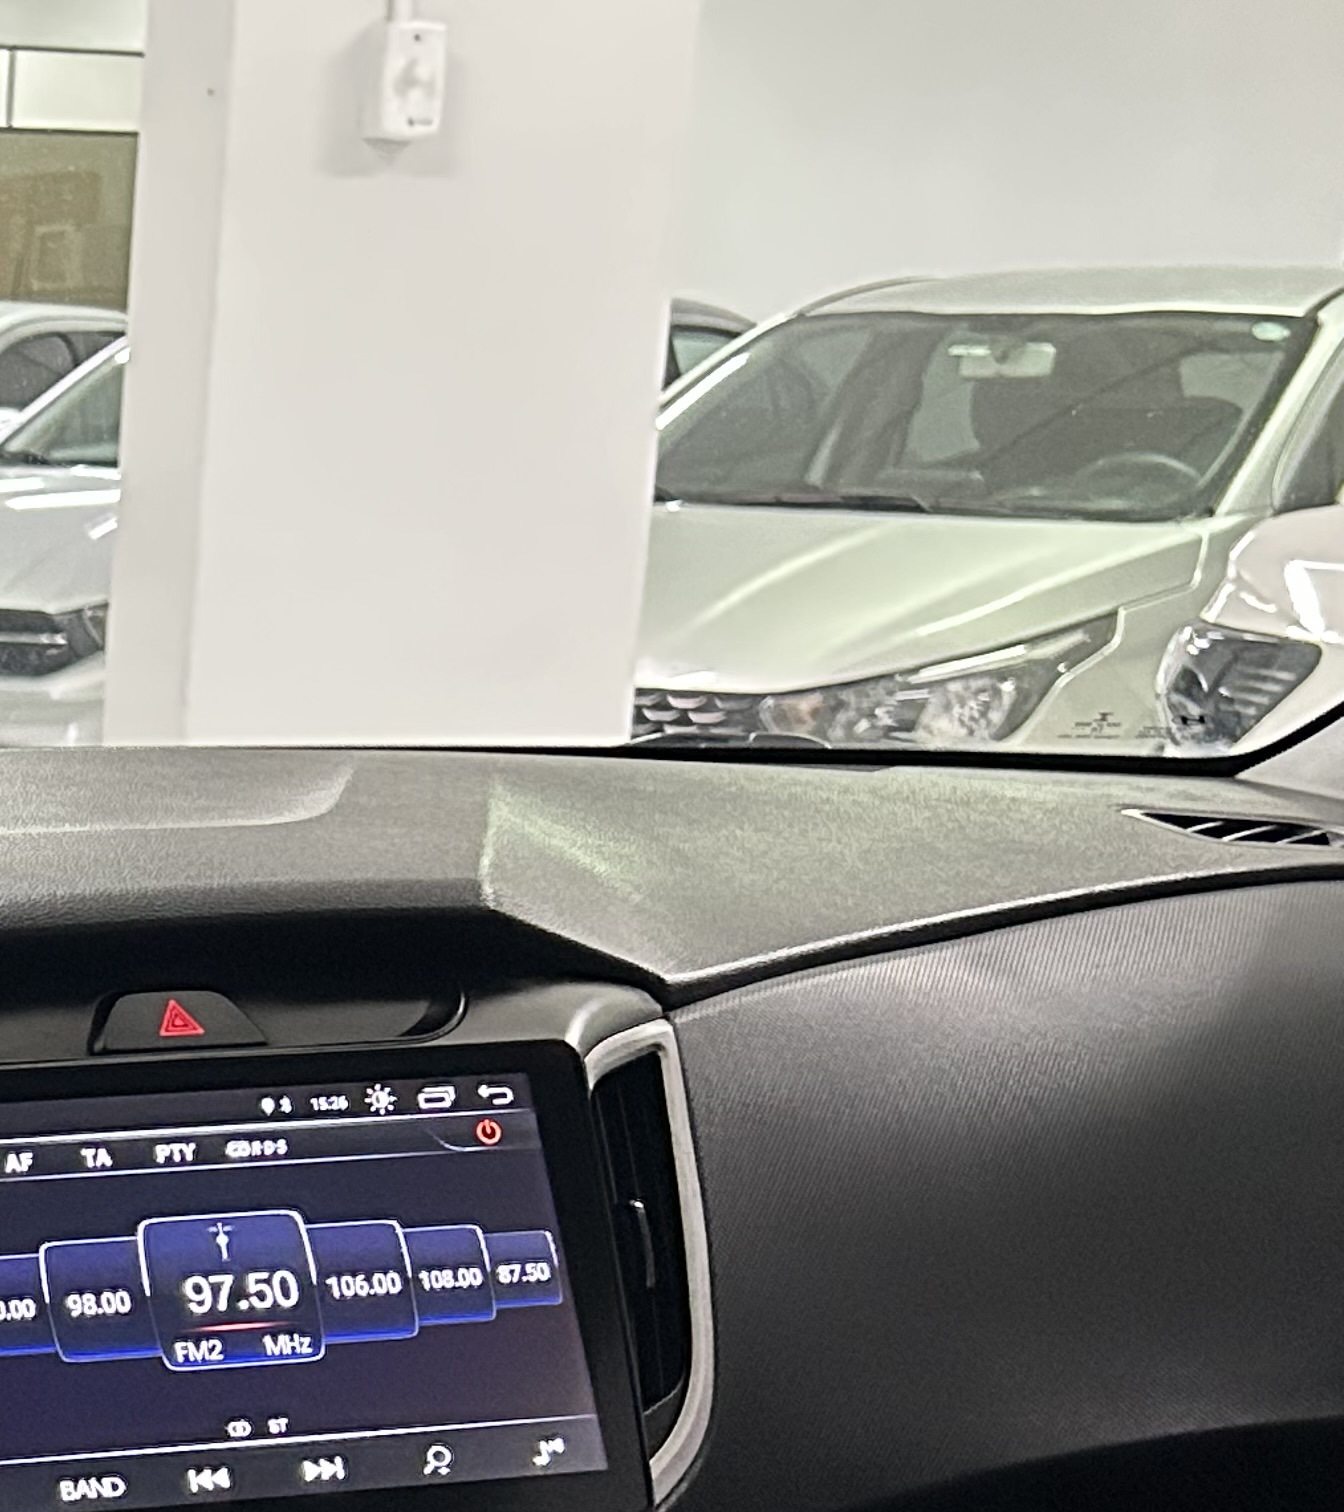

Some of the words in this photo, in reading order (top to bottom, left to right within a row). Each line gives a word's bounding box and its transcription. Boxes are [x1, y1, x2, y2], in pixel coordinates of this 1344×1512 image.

[5, 1153, 33, 1173] AF
[81, 1148, 112, 1168] TA
[155, 1143, 196, 1163] PTY
[418, 1268, 483, 1291] 108.00
[496, 1263, 551, 1283] 87.50
[183, 1270, 299, 1314] 97.50
[326, 1271, 402, 1299] 106.00
[65, 1289, 131, 1317] 98.00
[174, 1342, 224, 1362] FM2
[264, 1334, 312, 1356] MHz
[60, 1477, 126, 1501] BAND
